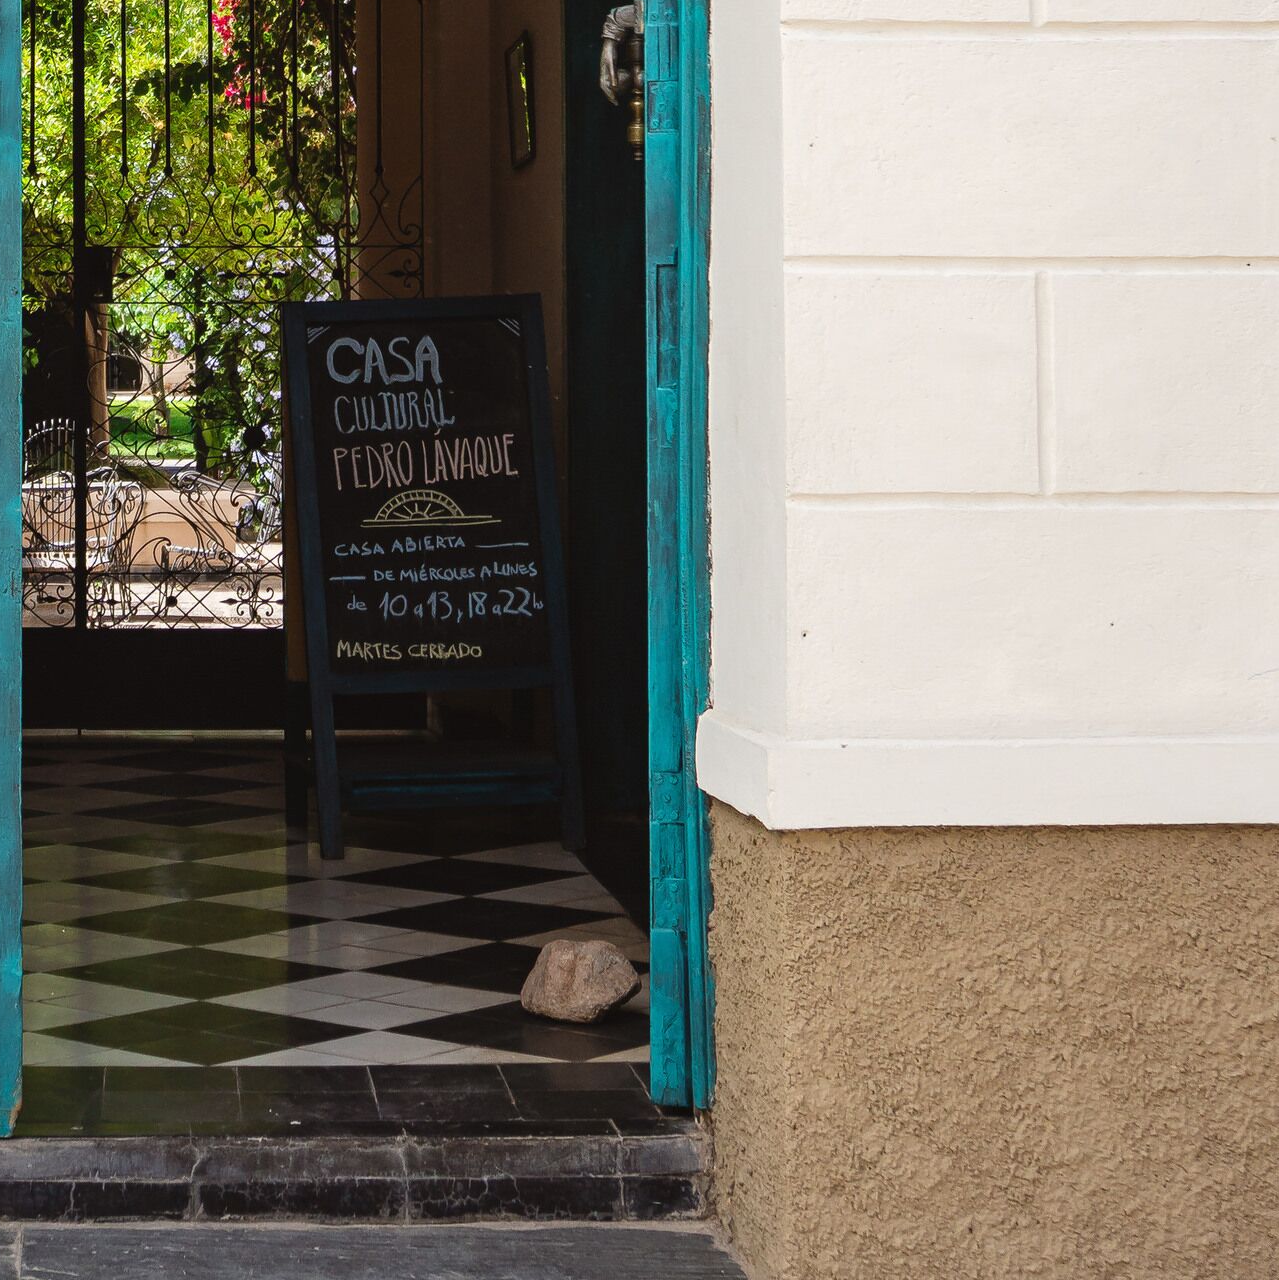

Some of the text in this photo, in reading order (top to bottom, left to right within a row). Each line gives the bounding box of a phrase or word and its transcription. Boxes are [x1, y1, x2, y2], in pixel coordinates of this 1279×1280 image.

[326, 334, 443, 385] CASA
[334, 387, 456, 434] CULTURAL
[333, 440, 413, 491] PEDRO
[334, 535, 466, 557] CASA ABIERTA
[374, 561, 538, 583] DE MIÉRCOLES A LUNES
[347, 592, 368, 611] de
[379, 591, 407, 620] 10
[427, 591, 452, 620] 13
[468, 592, 487, 619] 18
[498, 587, 533, 617] 22
[336, 639, 483, 661] MARTES CERRADO
